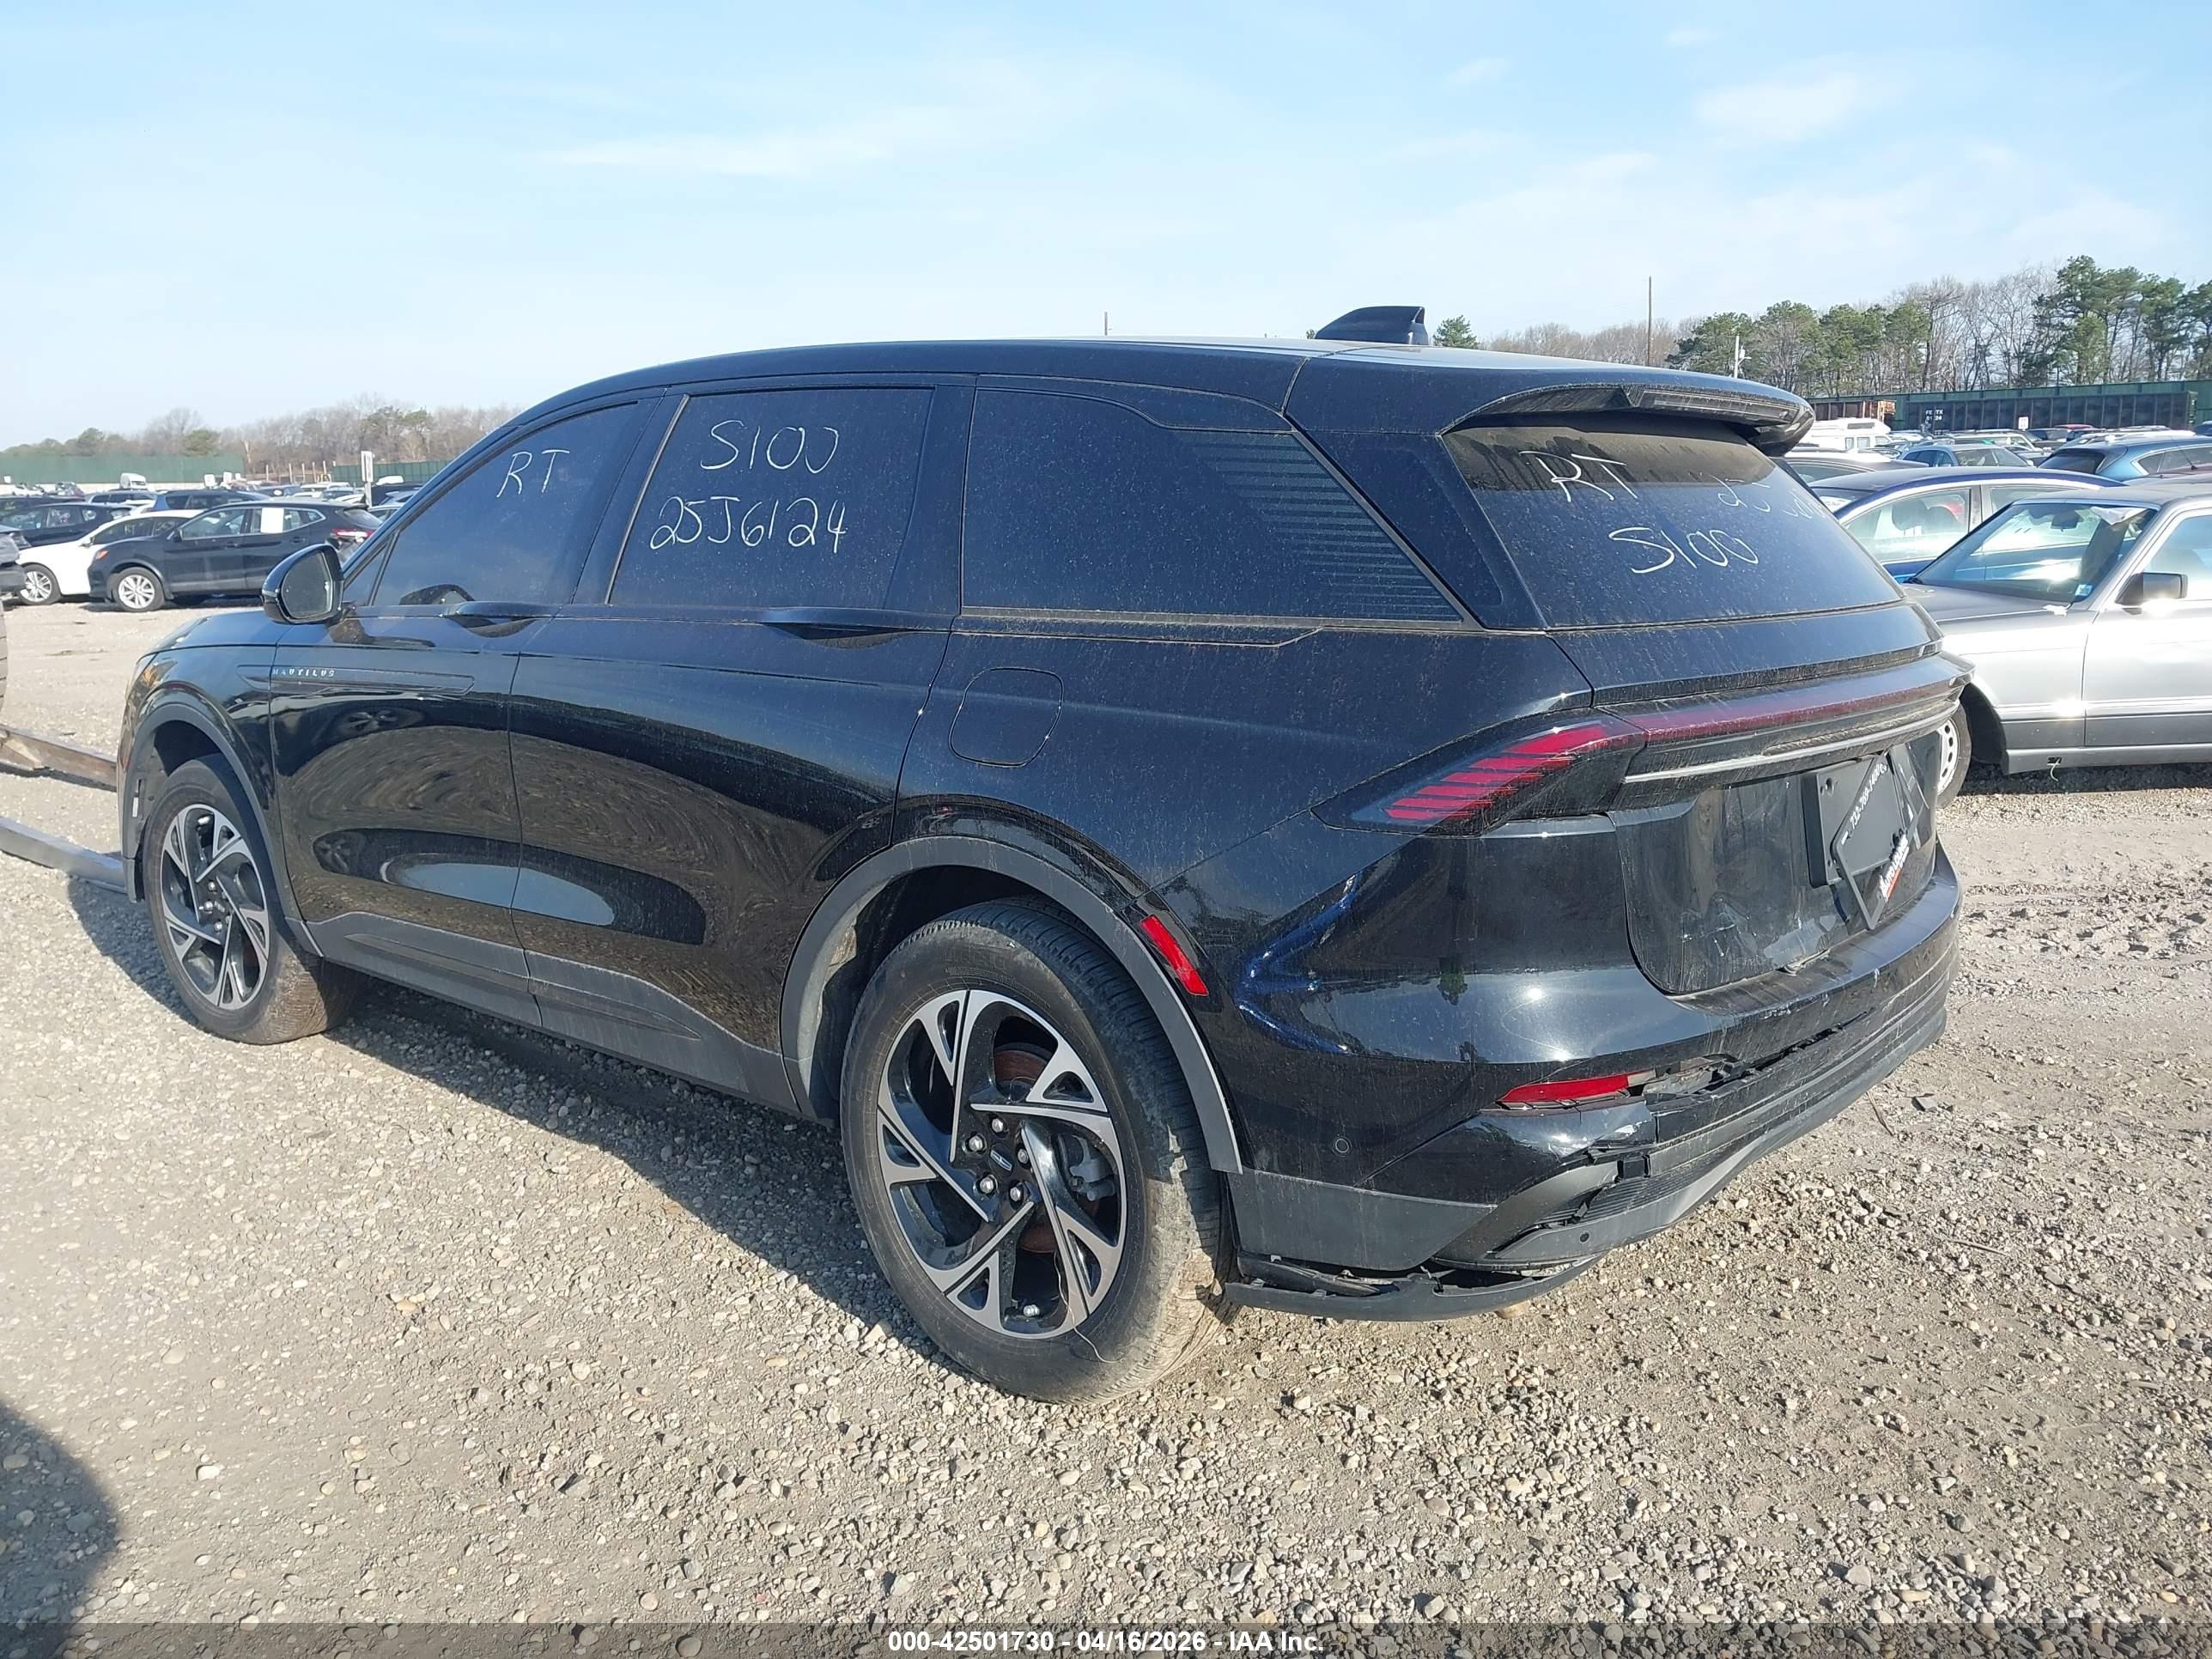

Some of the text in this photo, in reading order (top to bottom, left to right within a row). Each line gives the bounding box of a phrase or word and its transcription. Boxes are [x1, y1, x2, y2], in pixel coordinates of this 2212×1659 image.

[700, 419, 840, 474] S100
[495, 449, 570, 498] RT
[1518, 450, 1638, 502] RT
[649, 495, 847, 554] 25J6124
[1607, 526, 1759, 574] S100
[272, 668, 335, 678] NAUTILUS
